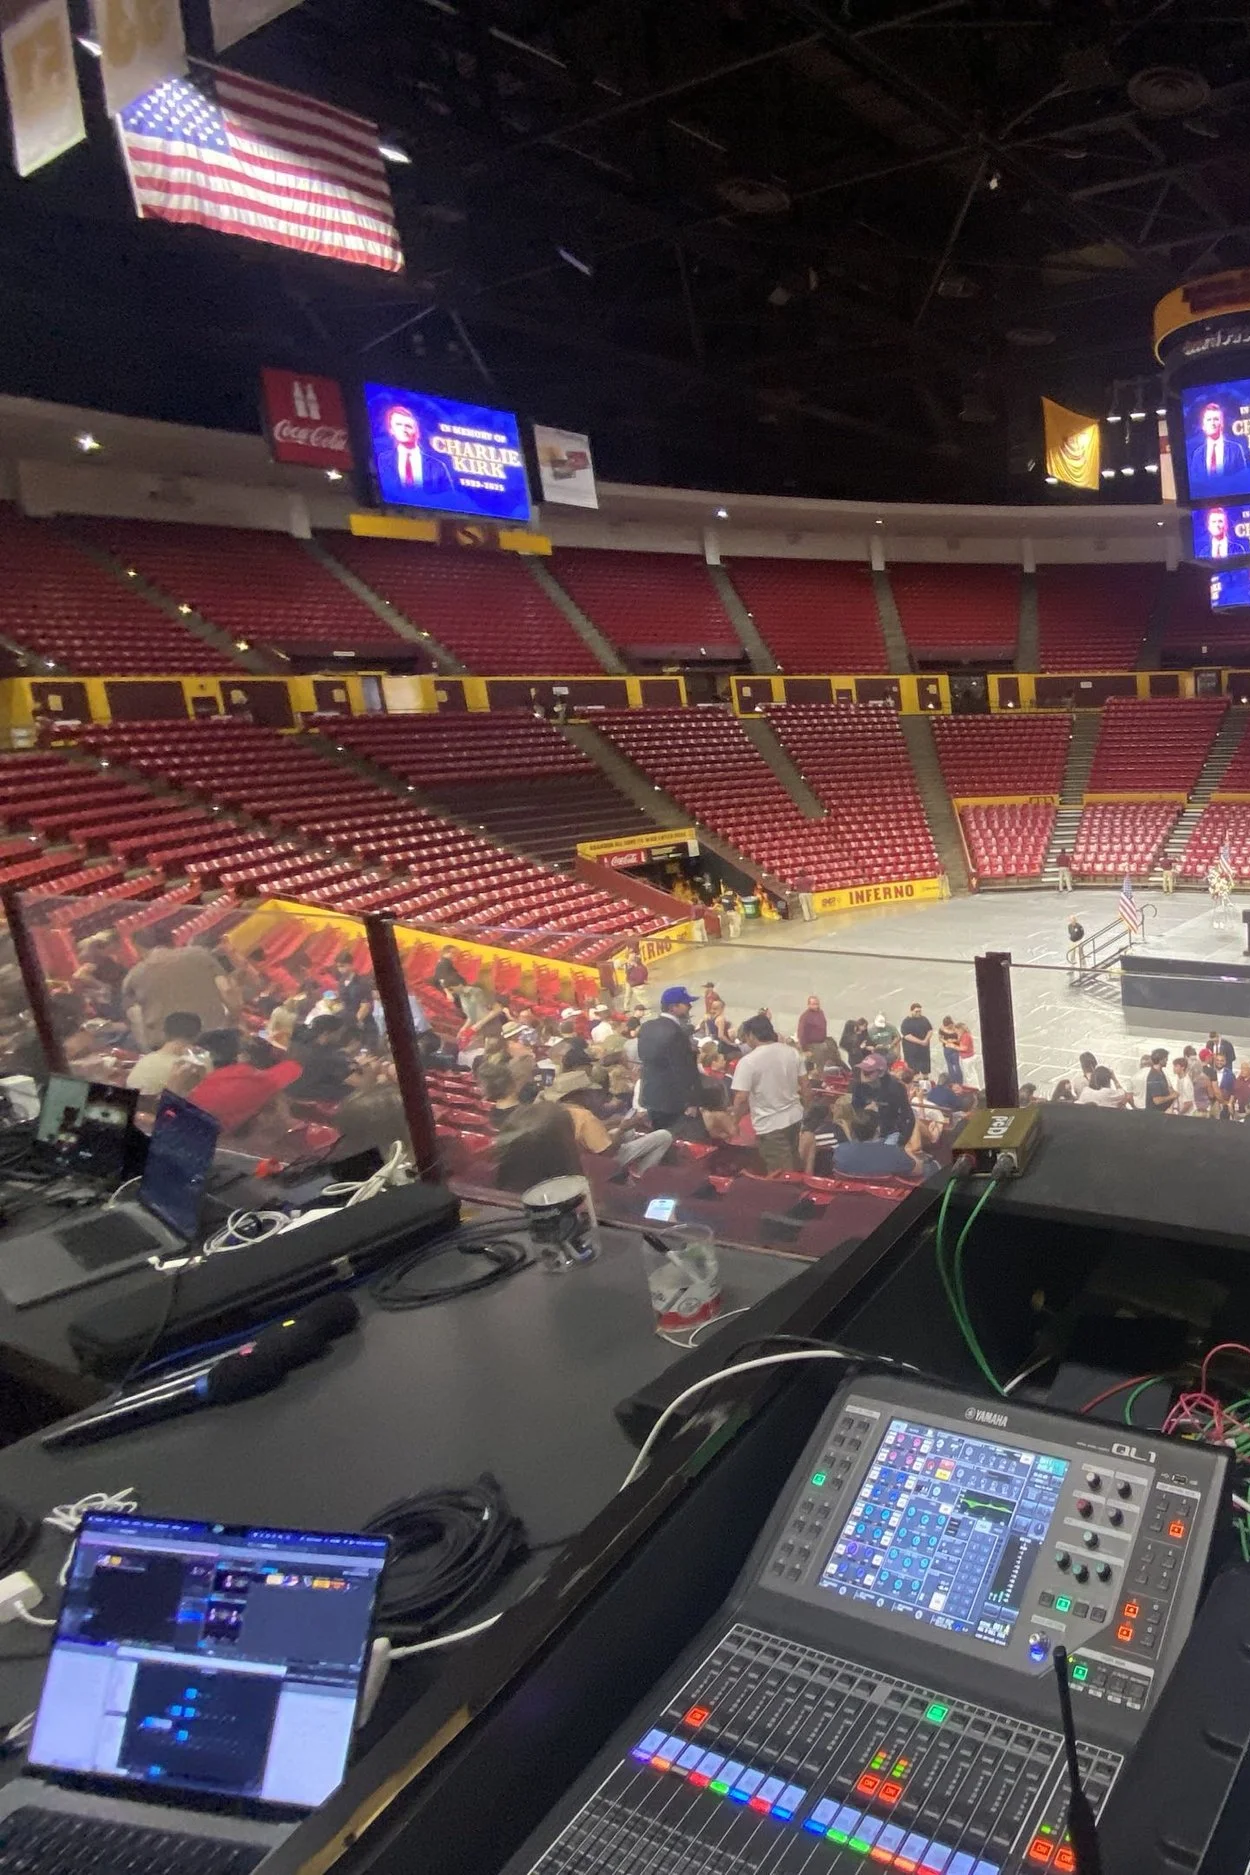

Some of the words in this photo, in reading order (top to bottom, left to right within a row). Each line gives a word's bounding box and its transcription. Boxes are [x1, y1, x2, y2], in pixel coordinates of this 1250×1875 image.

[273, 419, 348, 450] Coca-Cola
[451, 426, 493, 440] MEMORY
[494, 433, 507, 443] OF
[430, 436, 522, 467] CHARLIE
[453, 455, 506, 479] KIRK
[611, 853, 638, 867] Coca-Cola
[849, 884, 915, 905] INFERNO
[975, 1409, 1009, 1427] YAMAHA
[1111, 1443, 1157, 1463] QL1
